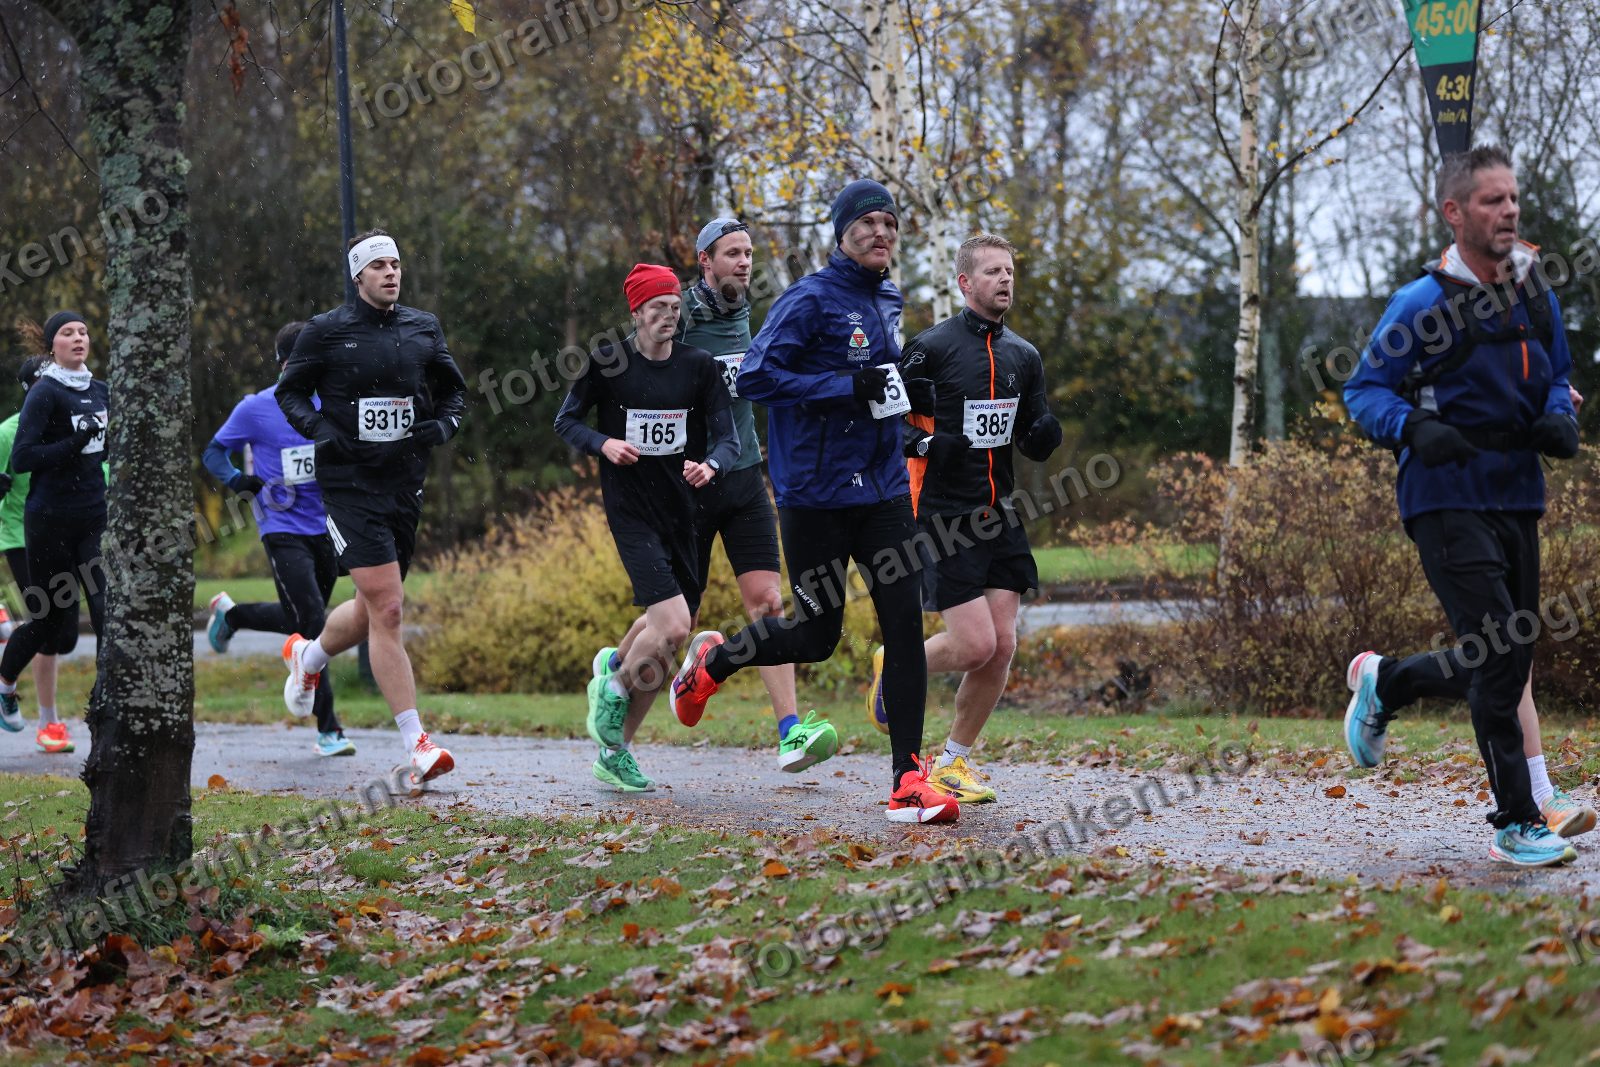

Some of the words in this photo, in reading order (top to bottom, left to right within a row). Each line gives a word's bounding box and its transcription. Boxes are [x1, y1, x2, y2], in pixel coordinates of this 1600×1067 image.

[364, 409, 411, 430] 9315
[632, 412, 684, 420] NORGESTESTEN
[976, 412, 1009, 436] 385
[640, 422, 675, 444] 165
[292, 457, 314, 476] 76
[794, 584, 821, 612] TRIMTEX
